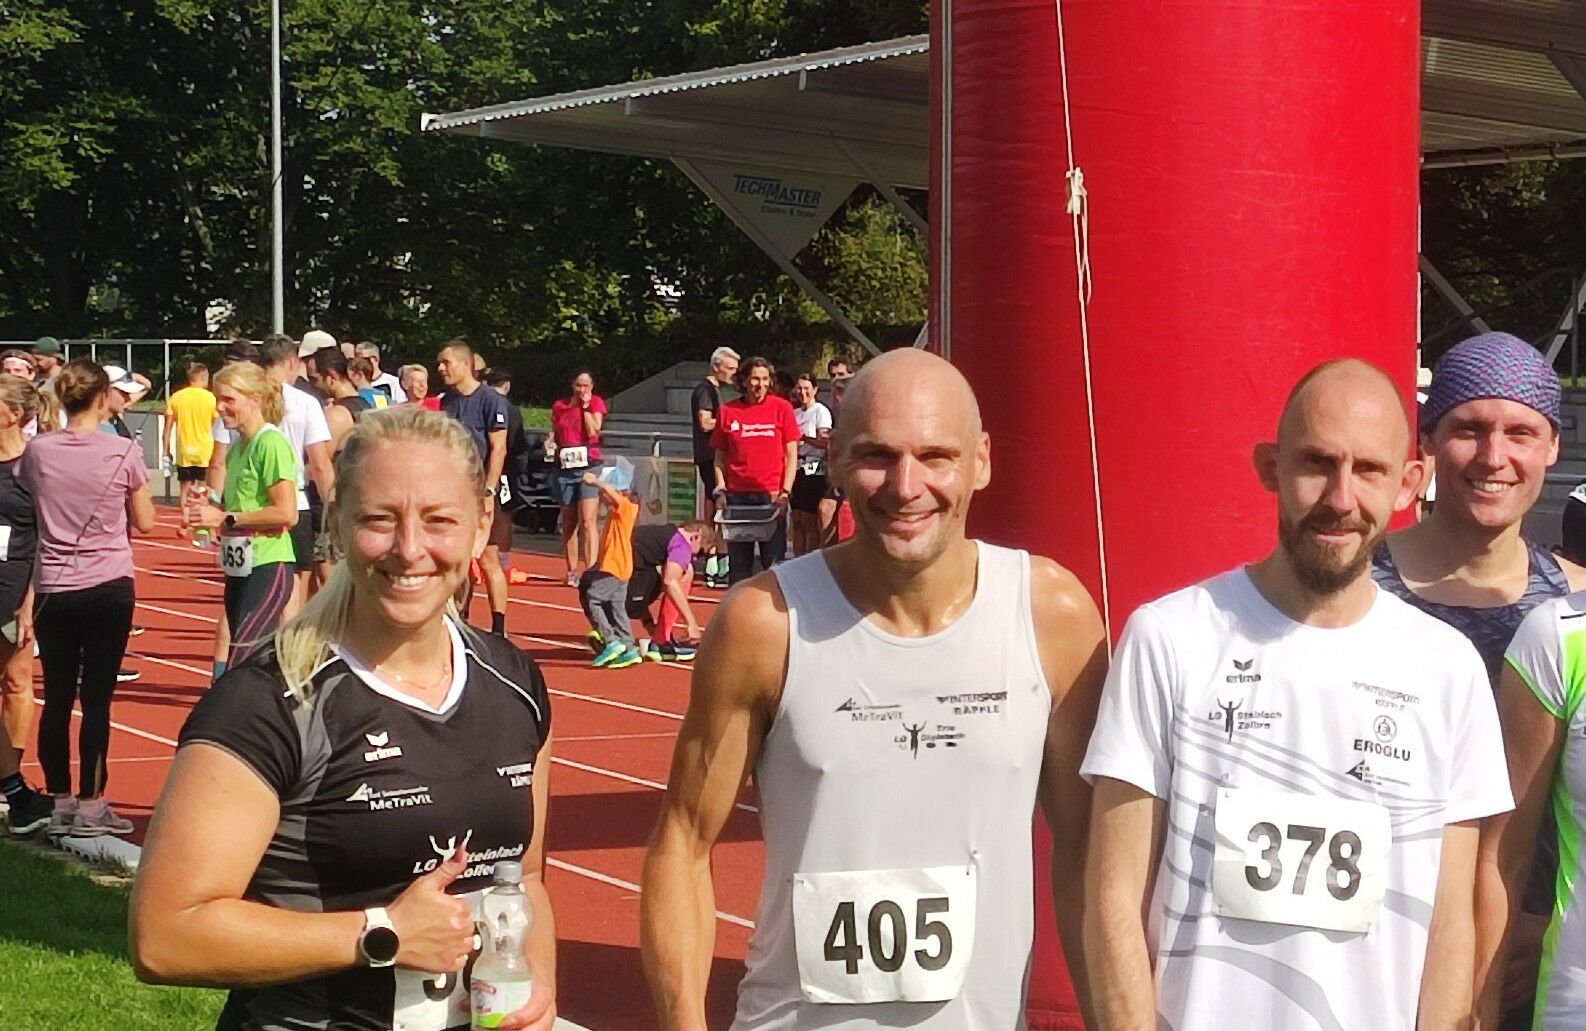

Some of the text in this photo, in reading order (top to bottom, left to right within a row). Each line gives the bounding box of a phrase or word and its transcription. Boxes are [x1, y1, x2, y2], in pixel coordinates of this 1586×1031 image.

[1353, 738, 1411, 762] EROGLU
[1244, 821, 1363, 901] 378
[823, 896, 953, 975] 405
